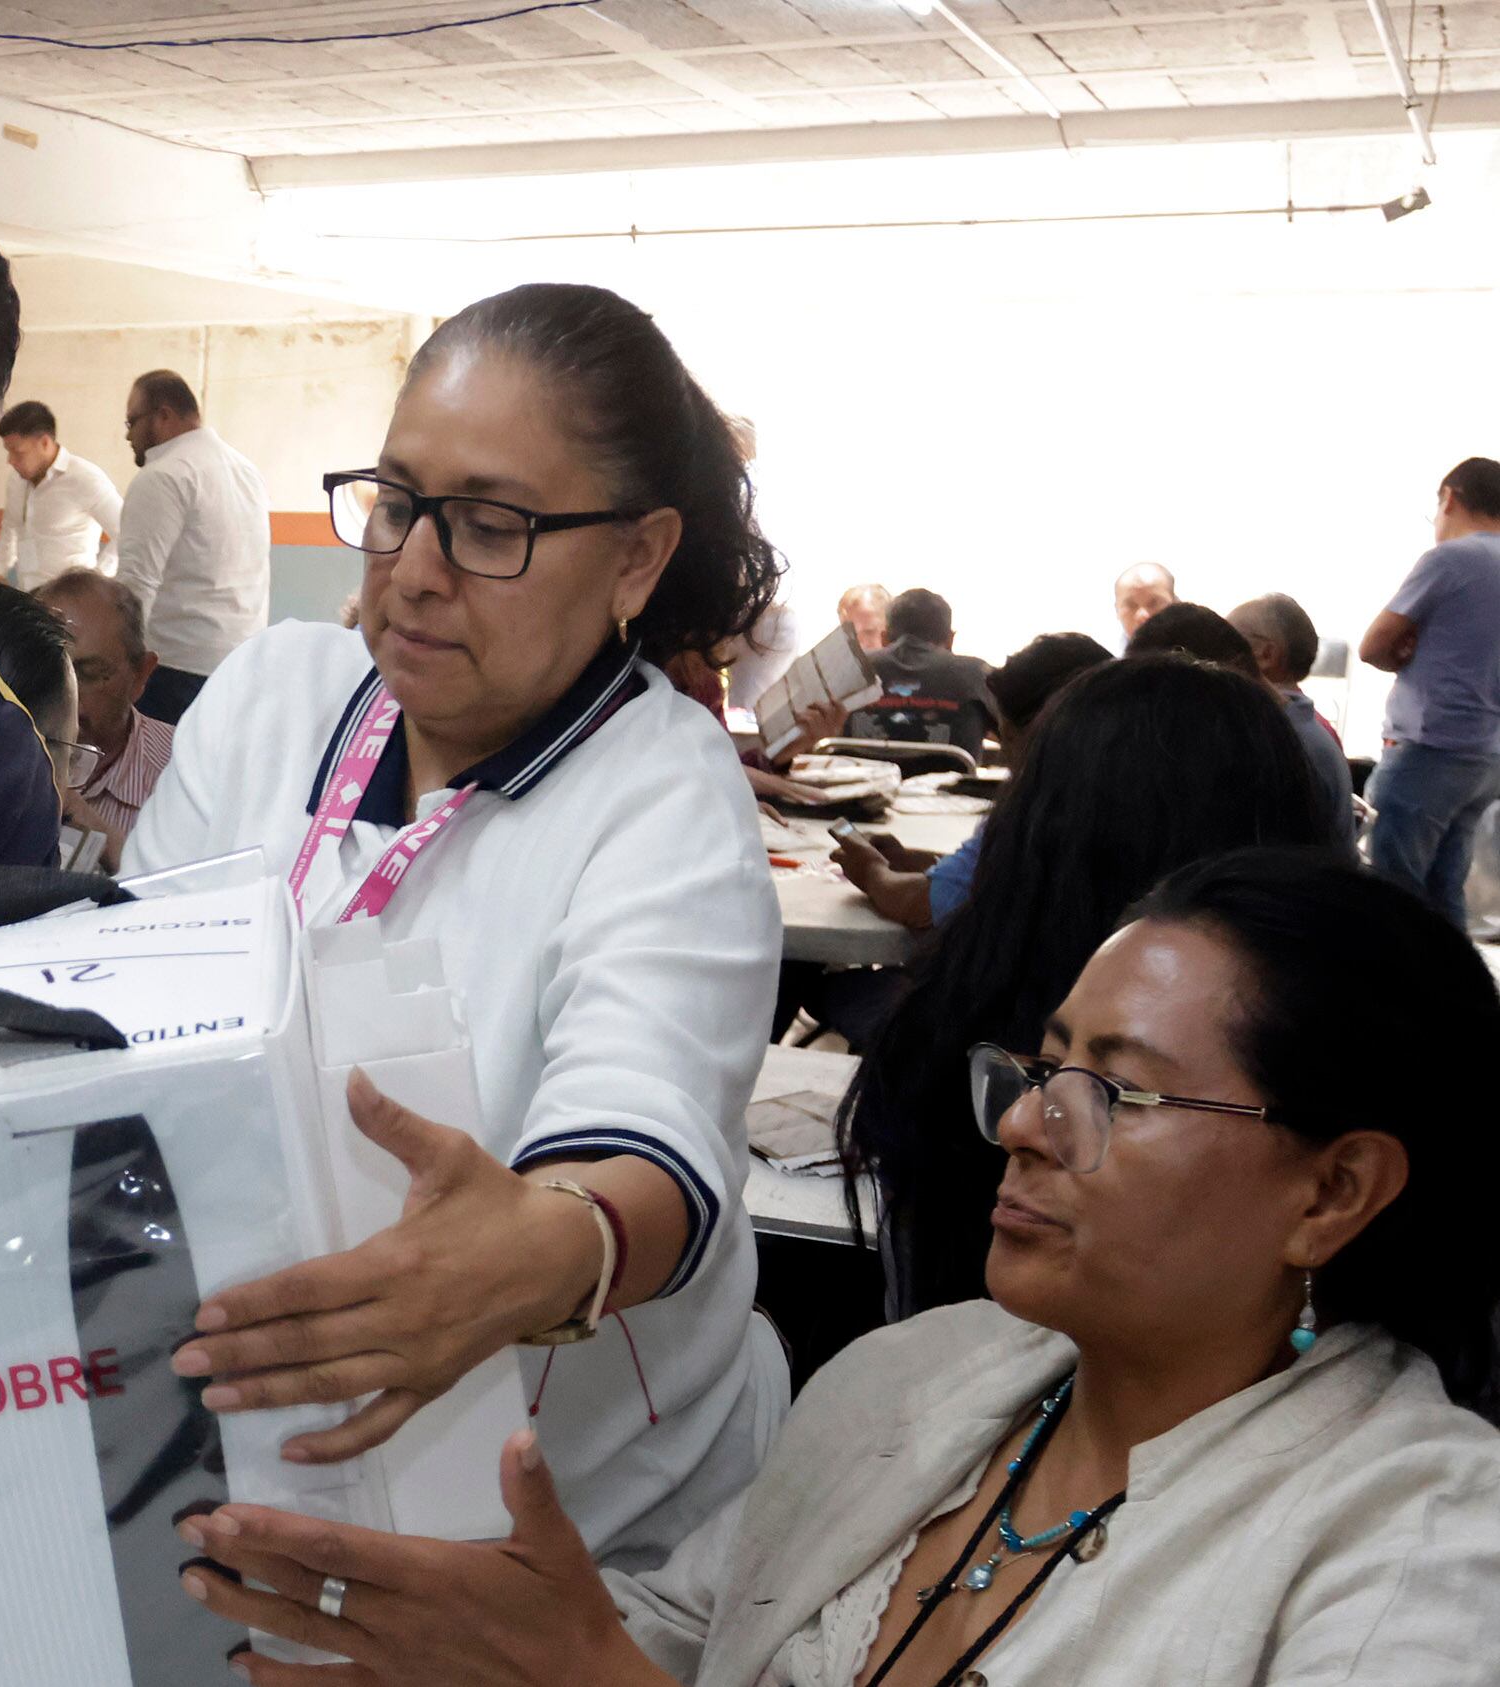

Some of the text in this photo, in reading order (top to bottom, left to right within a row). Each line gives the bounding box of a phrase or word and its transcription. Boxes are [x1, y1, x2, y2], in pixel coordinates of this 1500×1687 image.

[358, 700, 401, 759] NE
[381, 807, 455, 886] INE
[41, 962, 116, 984] 21
[125, 1016, 244, 1043] ENTID
